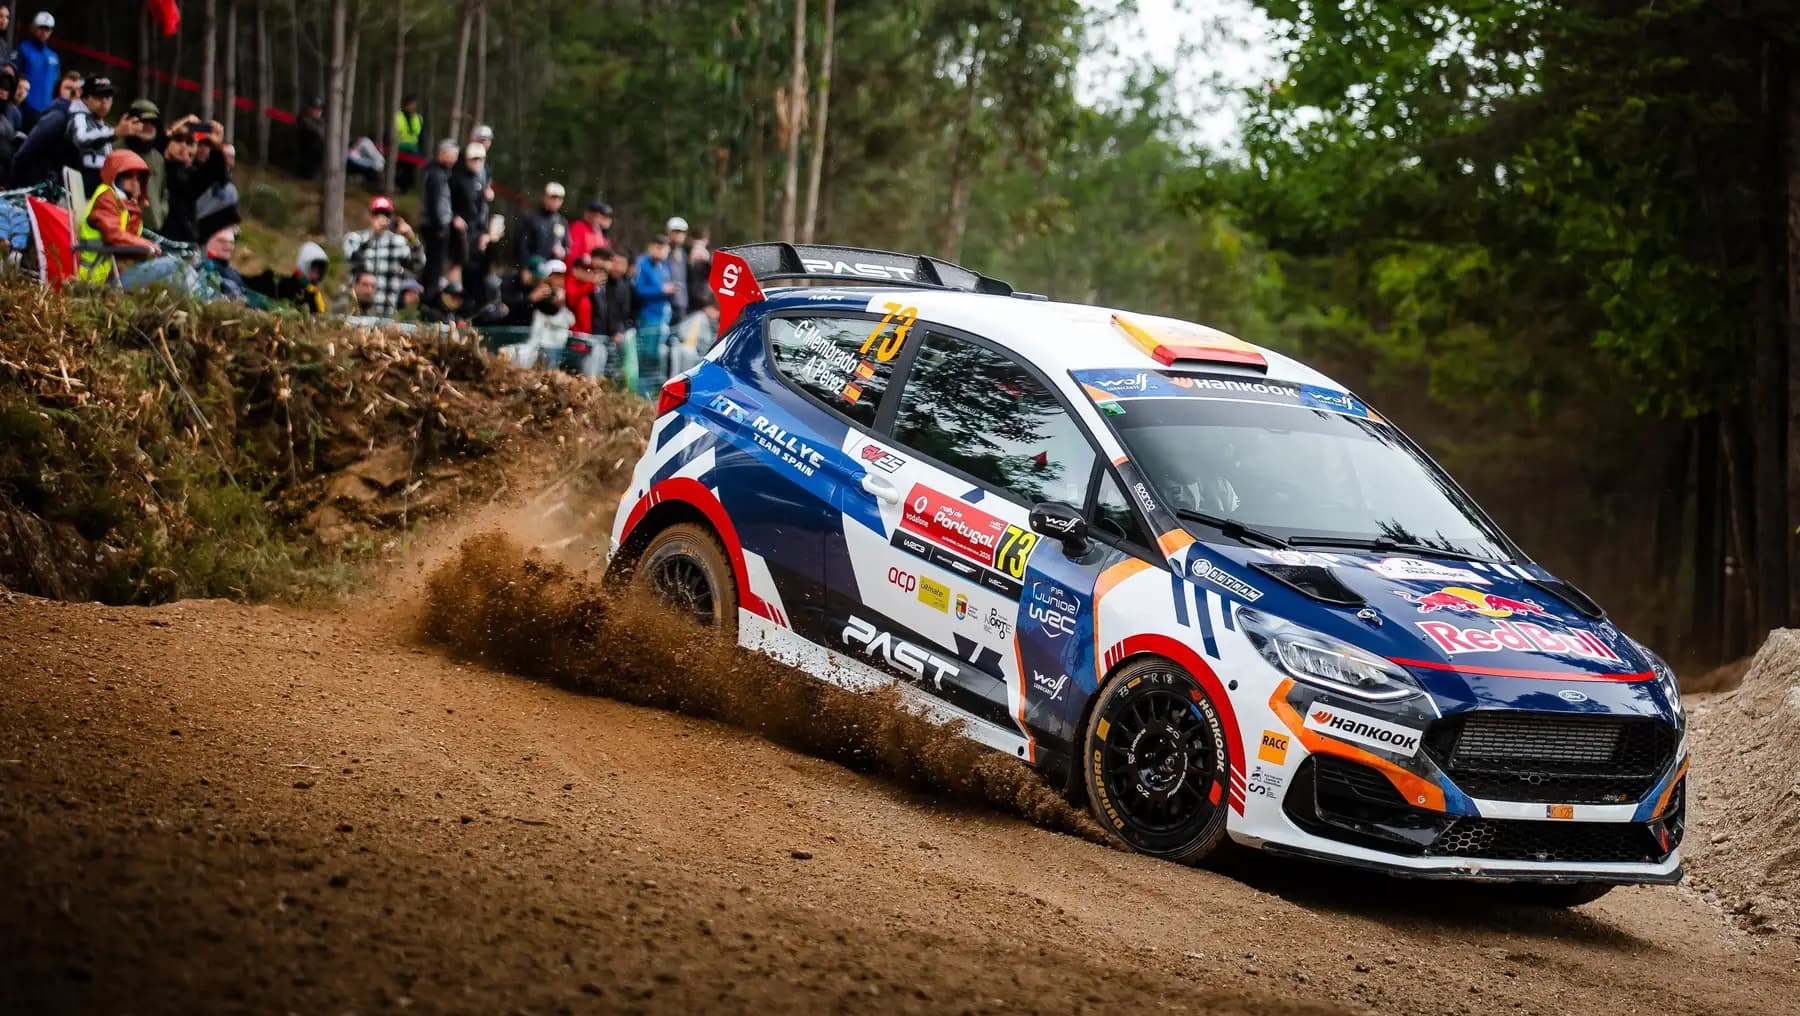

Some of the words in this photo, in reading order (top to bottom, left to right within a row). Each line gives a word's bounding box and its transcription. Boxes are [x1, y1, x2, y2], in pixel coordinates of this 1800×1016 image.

[801, 258, 914, 280] PAST
[804, 326, 858, 374] Membrado
[860, 302, 918, 362] 73
[814, 362, 846, 395] Pérez
[709, 394, 749, 423] RTS
[752, 415, 825, 469] RALLYE
[753, 432, 781, 456] TEAM
[782, 452, 815, 477] SPAIN
[934, 511, 994, 548] Portugal
[997, 523, 1038, 578] 73
[888, 566, 916, 592] acp
[1209, 569, 1260, 600] SETRAM
[842, 614, 960, 691] PAST
[1416, 619, 1537, 654] Red
[1512, 621, 1622, 663] Bull
[1033, 669, 1068, 700] wolf
[1262, 735, 1288, 750] RACC
